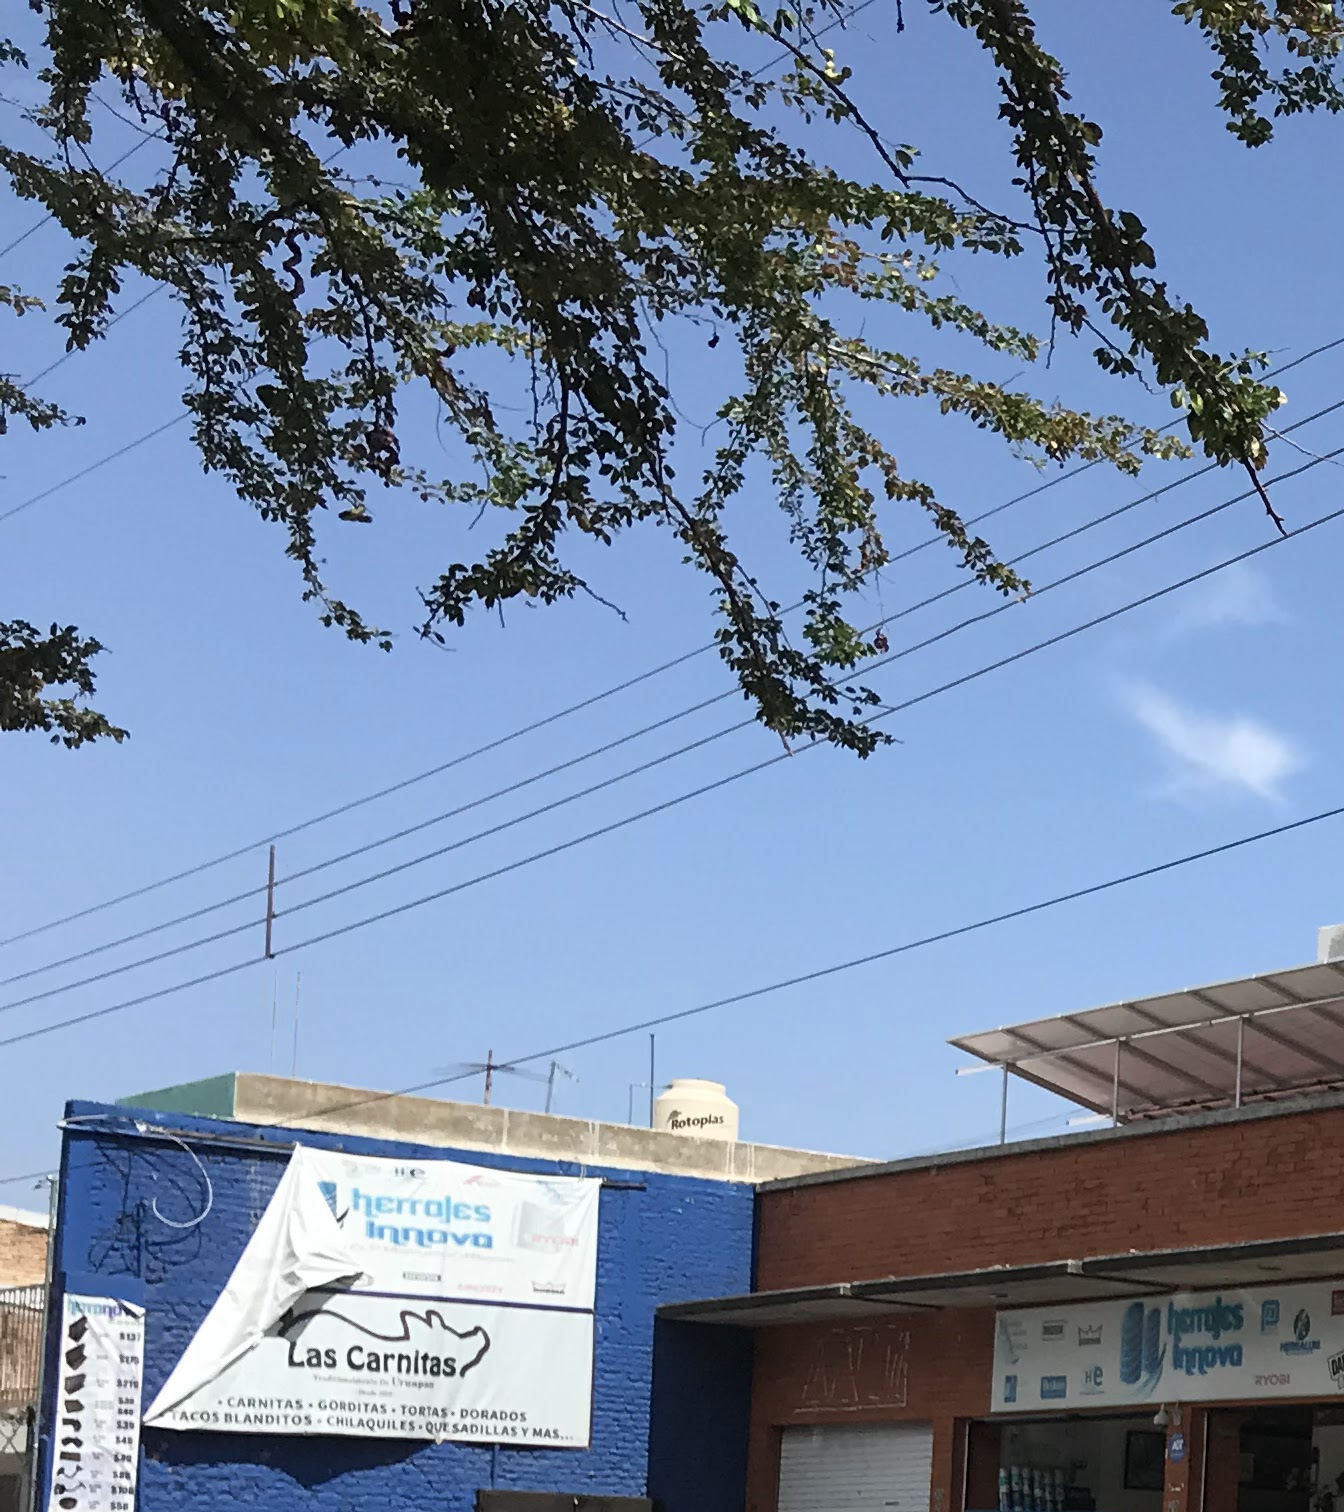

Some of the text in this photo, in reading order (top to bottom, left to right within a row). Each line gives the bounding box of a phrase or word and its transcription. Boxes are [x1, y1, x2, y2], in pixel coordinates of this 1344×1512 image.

[671, 1114, 724, 1130] Rotoplas
[288, 1341, 456, 1377] Las Carnitas
[1255, 1374, 1291, 1386] RYOBI
[227, 1396, 527, 1422] CARNITAS GORDITAS TORTAS DORADOS
[172, 1410, 220, 1423] TACOS
[224, 1412, 312, 1426] BLANDITOS
[327, 1415, 416, 1432] CHILAQUILES
[426, 1422, 518, 1437] QUESADILLAS
[521, 1427, 529, 1437] Y
